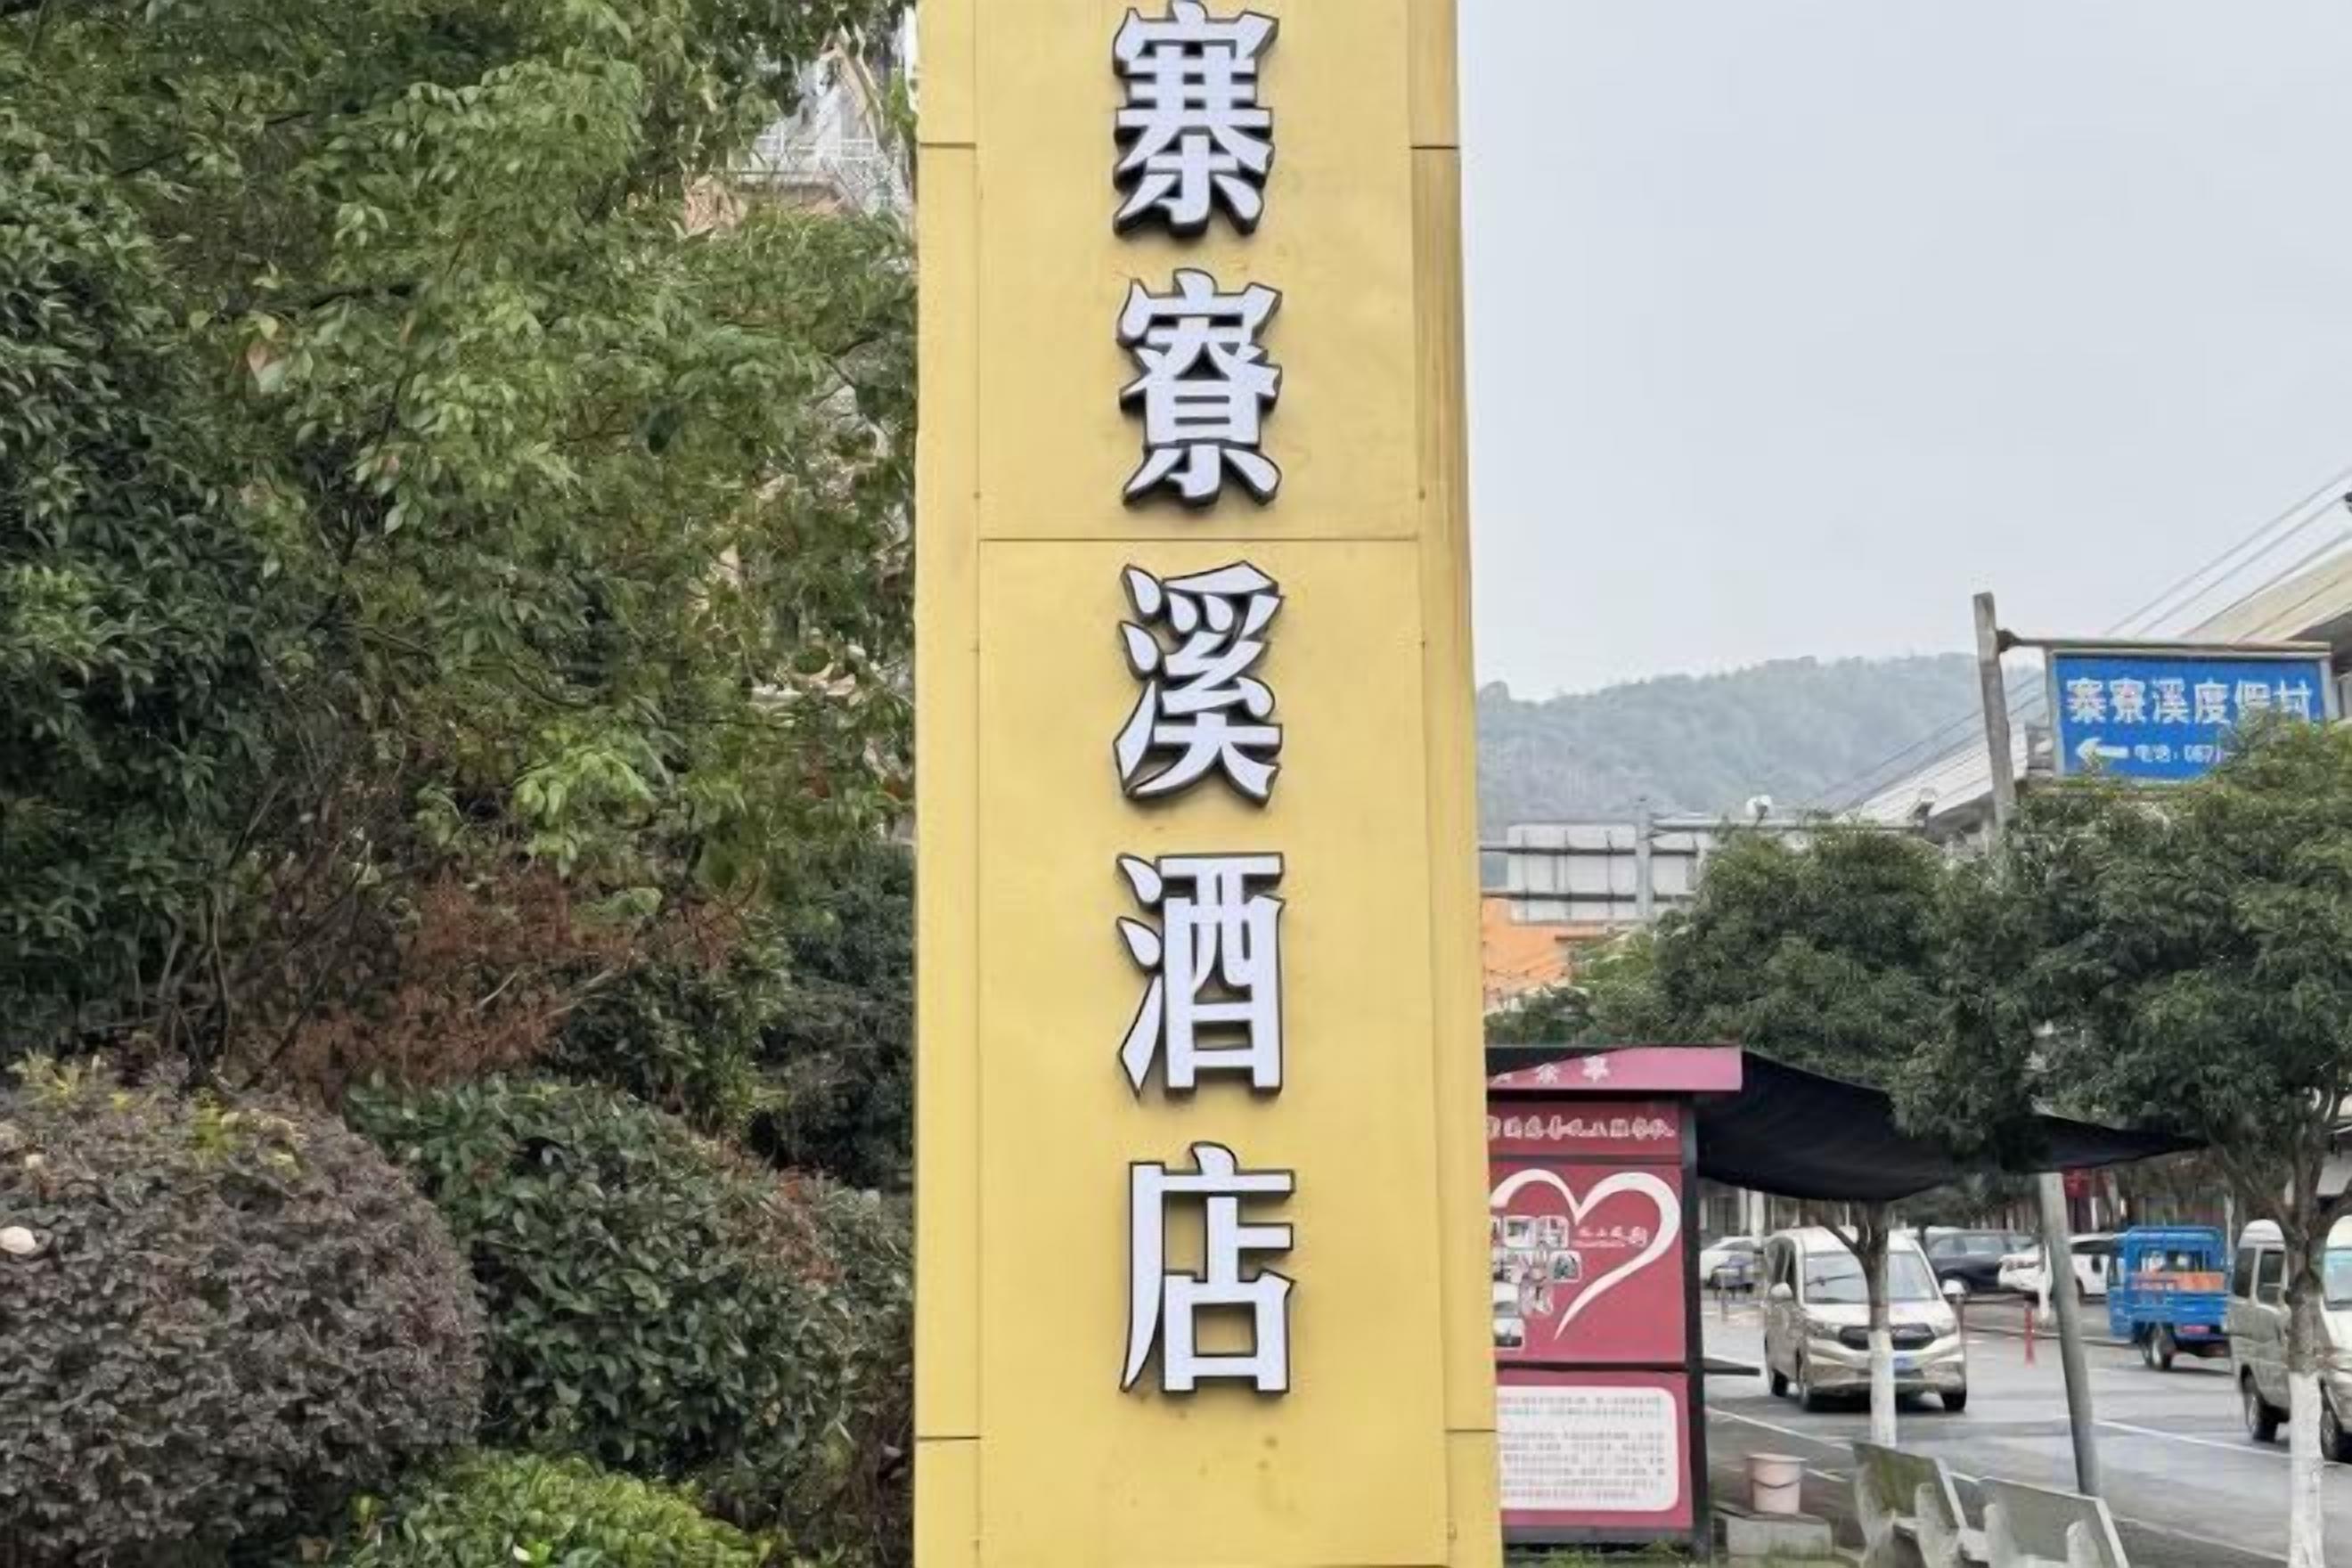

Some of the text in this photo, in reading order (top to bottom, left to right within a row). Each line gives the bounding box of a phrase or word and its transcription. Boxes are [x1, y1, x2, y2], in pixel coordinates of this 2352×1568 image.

[1113, 0, 1294, 1394] 寨寮溪酒店
